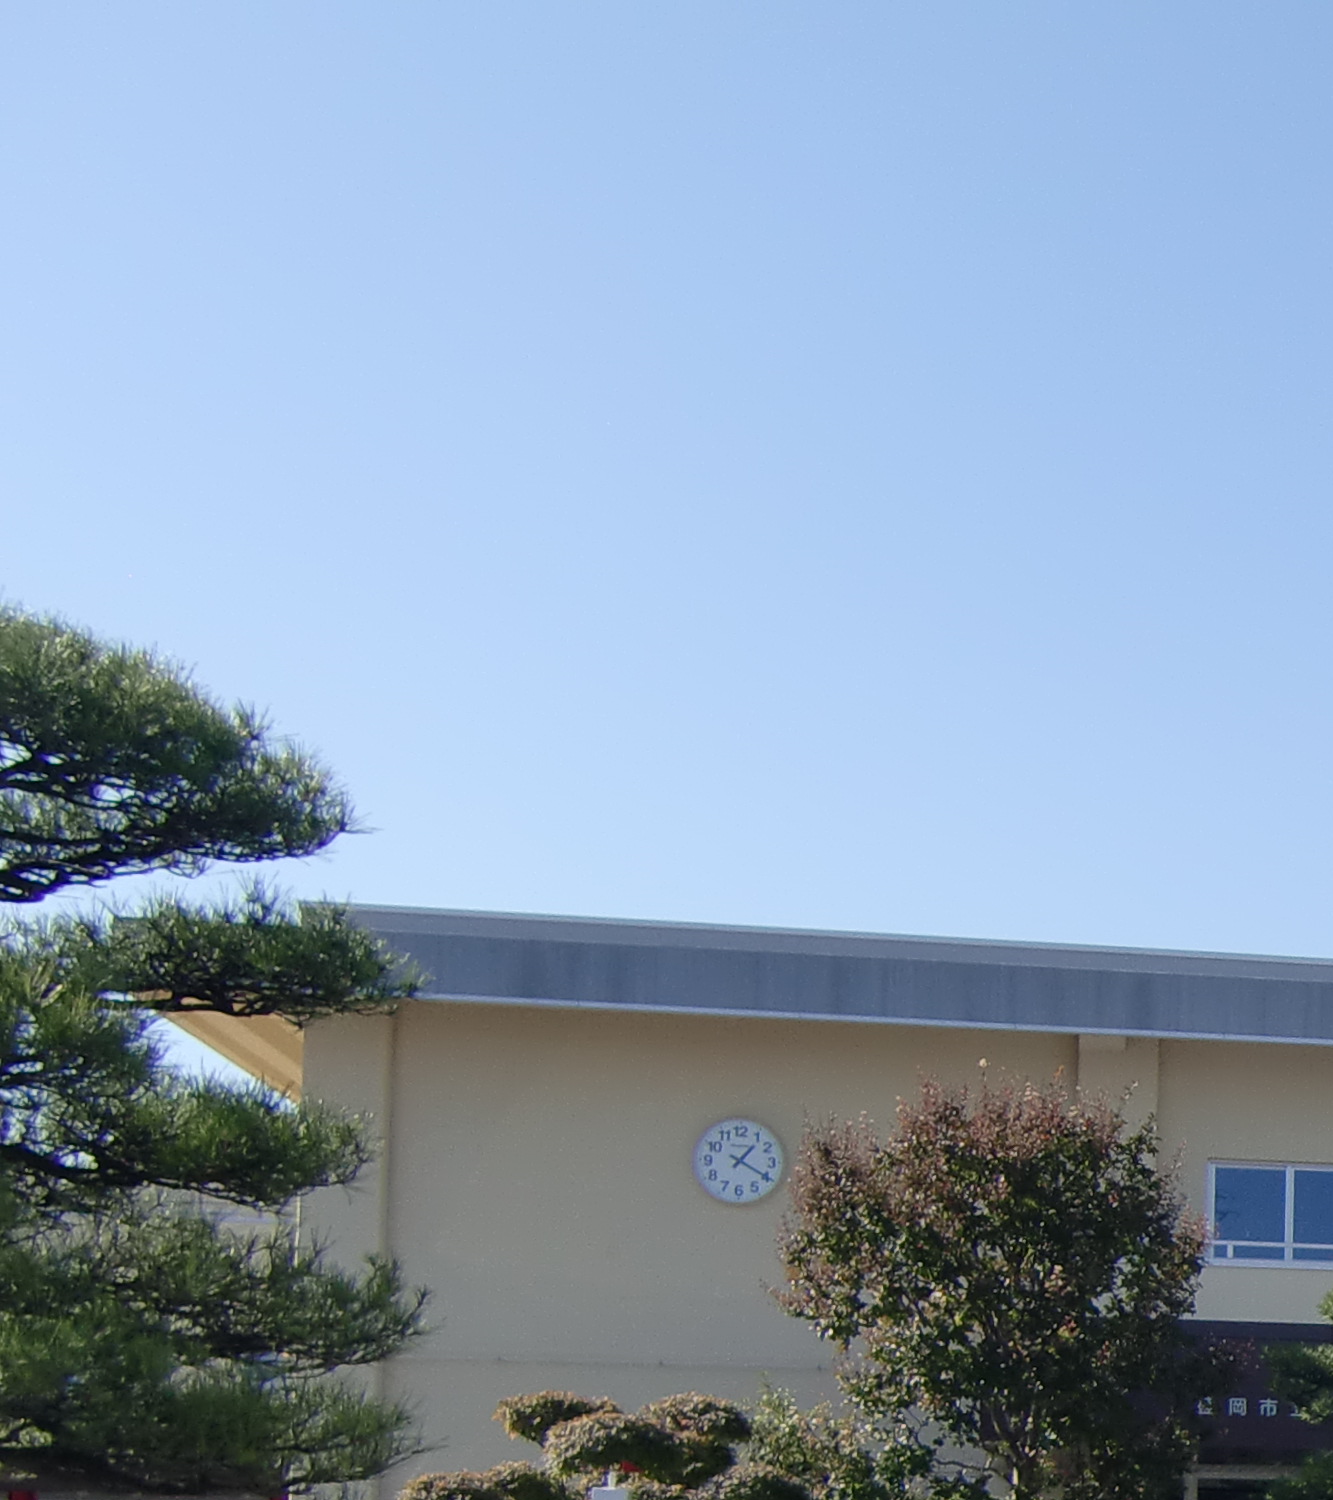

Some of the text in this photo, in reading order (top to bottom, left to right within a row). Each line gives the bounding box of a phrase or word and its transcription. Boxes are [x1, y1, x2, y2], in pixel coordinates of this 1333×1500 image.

[719, 1130, 731, 1141] 11
[733, 1126, 748, 1137] 12
[754, 1132, 760, 1142] 1
[708, 1141, 722, 1153] 10
[763, 1142, 772, 1153] 2
[704, 1154, 713, 1166] 9
[768, 1156, 776, 1169] 3
[708, 1169, 718, 1181] 8
[720, 1180, 730, 1192] 7
[735, 1185, 744, 1196] 6
[750, 1181, 759, 1193] 5
